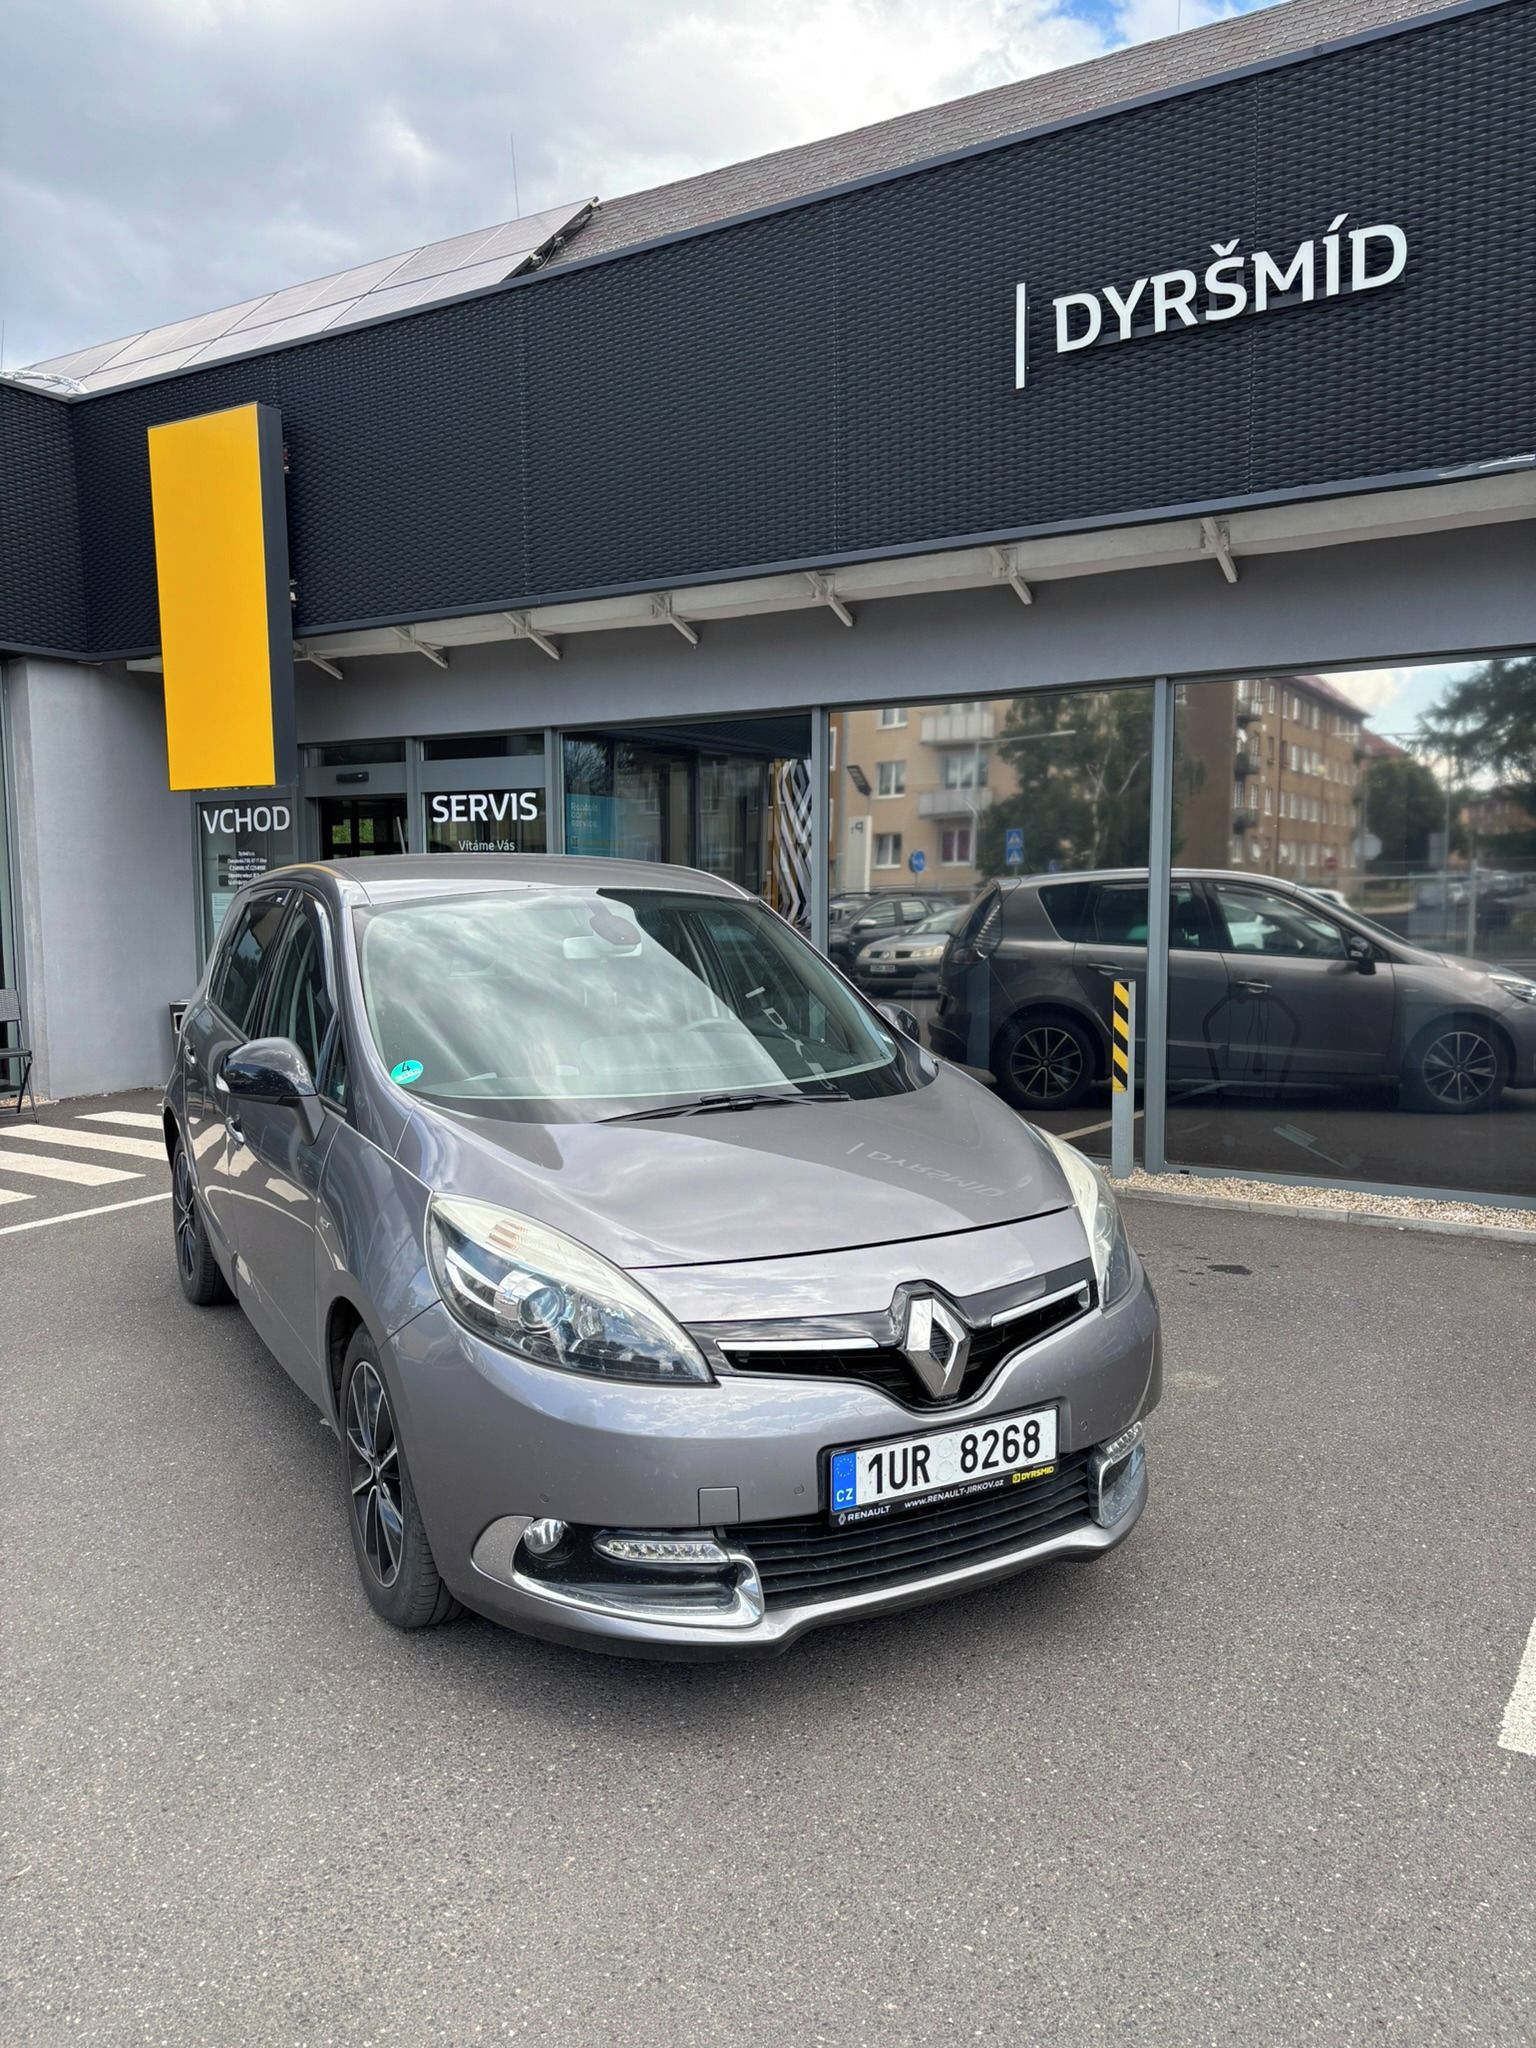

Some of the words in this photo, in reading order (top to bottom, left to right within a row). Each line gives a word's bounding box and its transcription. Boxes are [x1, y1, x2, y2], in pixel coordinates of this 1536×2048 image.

[1052, 213, 1408, 354] DYRŠMÍD
[202, 806, 291, 834] VCHOD
[432, 792, 538, 823] SERVIS
[496, 839, 515, 851] Vás
[868, 1444, 931, 1495] 1UR
[960, 1419, 1041, 1474] 8268
[836, 1487, 854, 1503] CZ
[904, 1479, 1004, 1508] www.RENAULT-JIRKOV.cz
[847, 1504, 892, 1521] RENAULT
